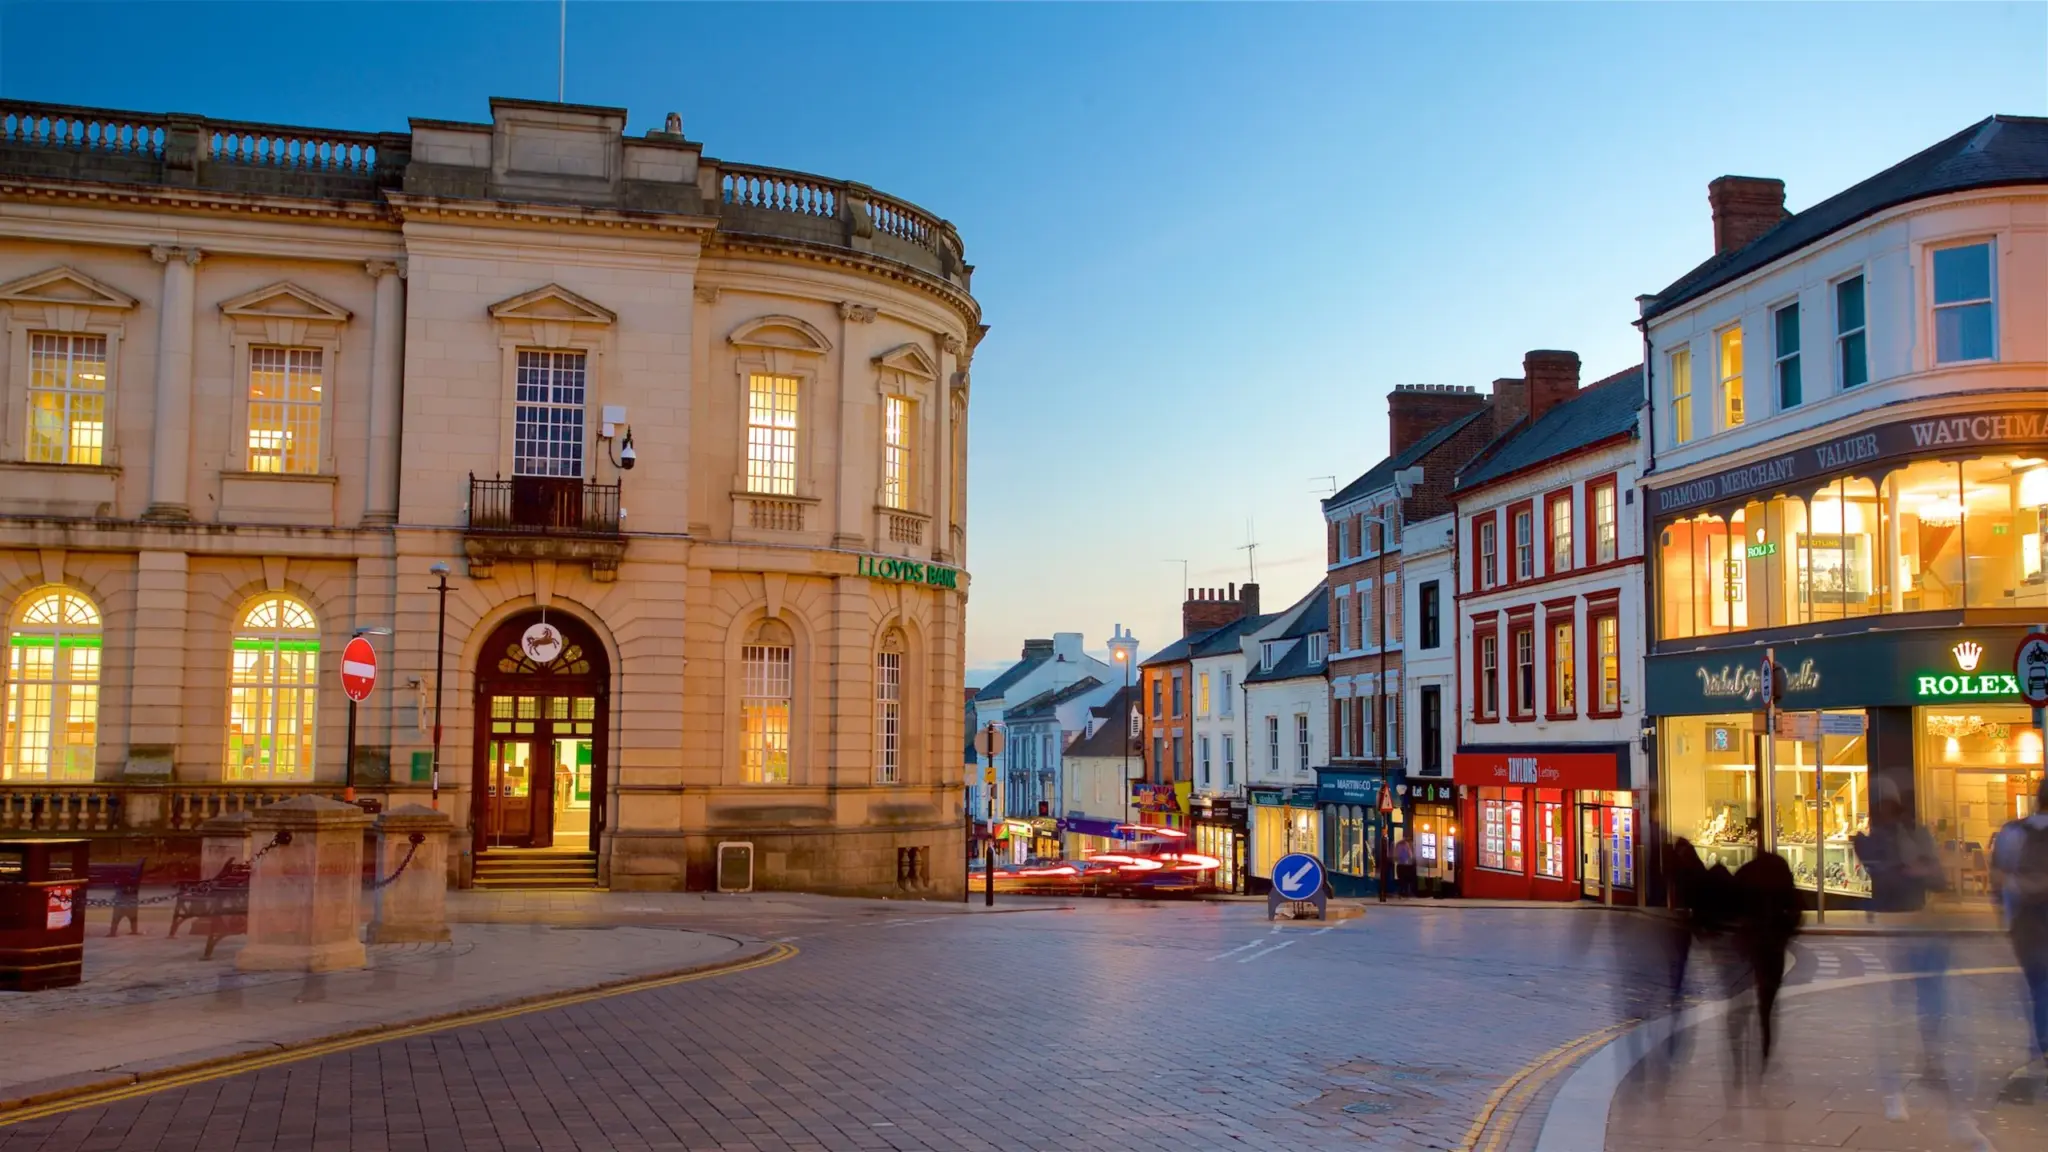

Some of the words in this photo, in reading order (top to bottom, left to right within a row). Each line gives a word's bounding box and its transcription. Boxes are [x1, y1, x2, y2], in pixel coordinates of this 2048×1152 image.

[1816, 434, 1879, 469] VALUER
[1660, 478, 1716, 510] DIAMOND
[1720, 456, 1795, 495] MERCHANT
[858, 555, 924, 582] LLOYDS
[926, 564, 957, 589] BANK
[1918, 675, 2020, 695] ROLEX
[1508, 757, 1538, 784] TAYLORS
